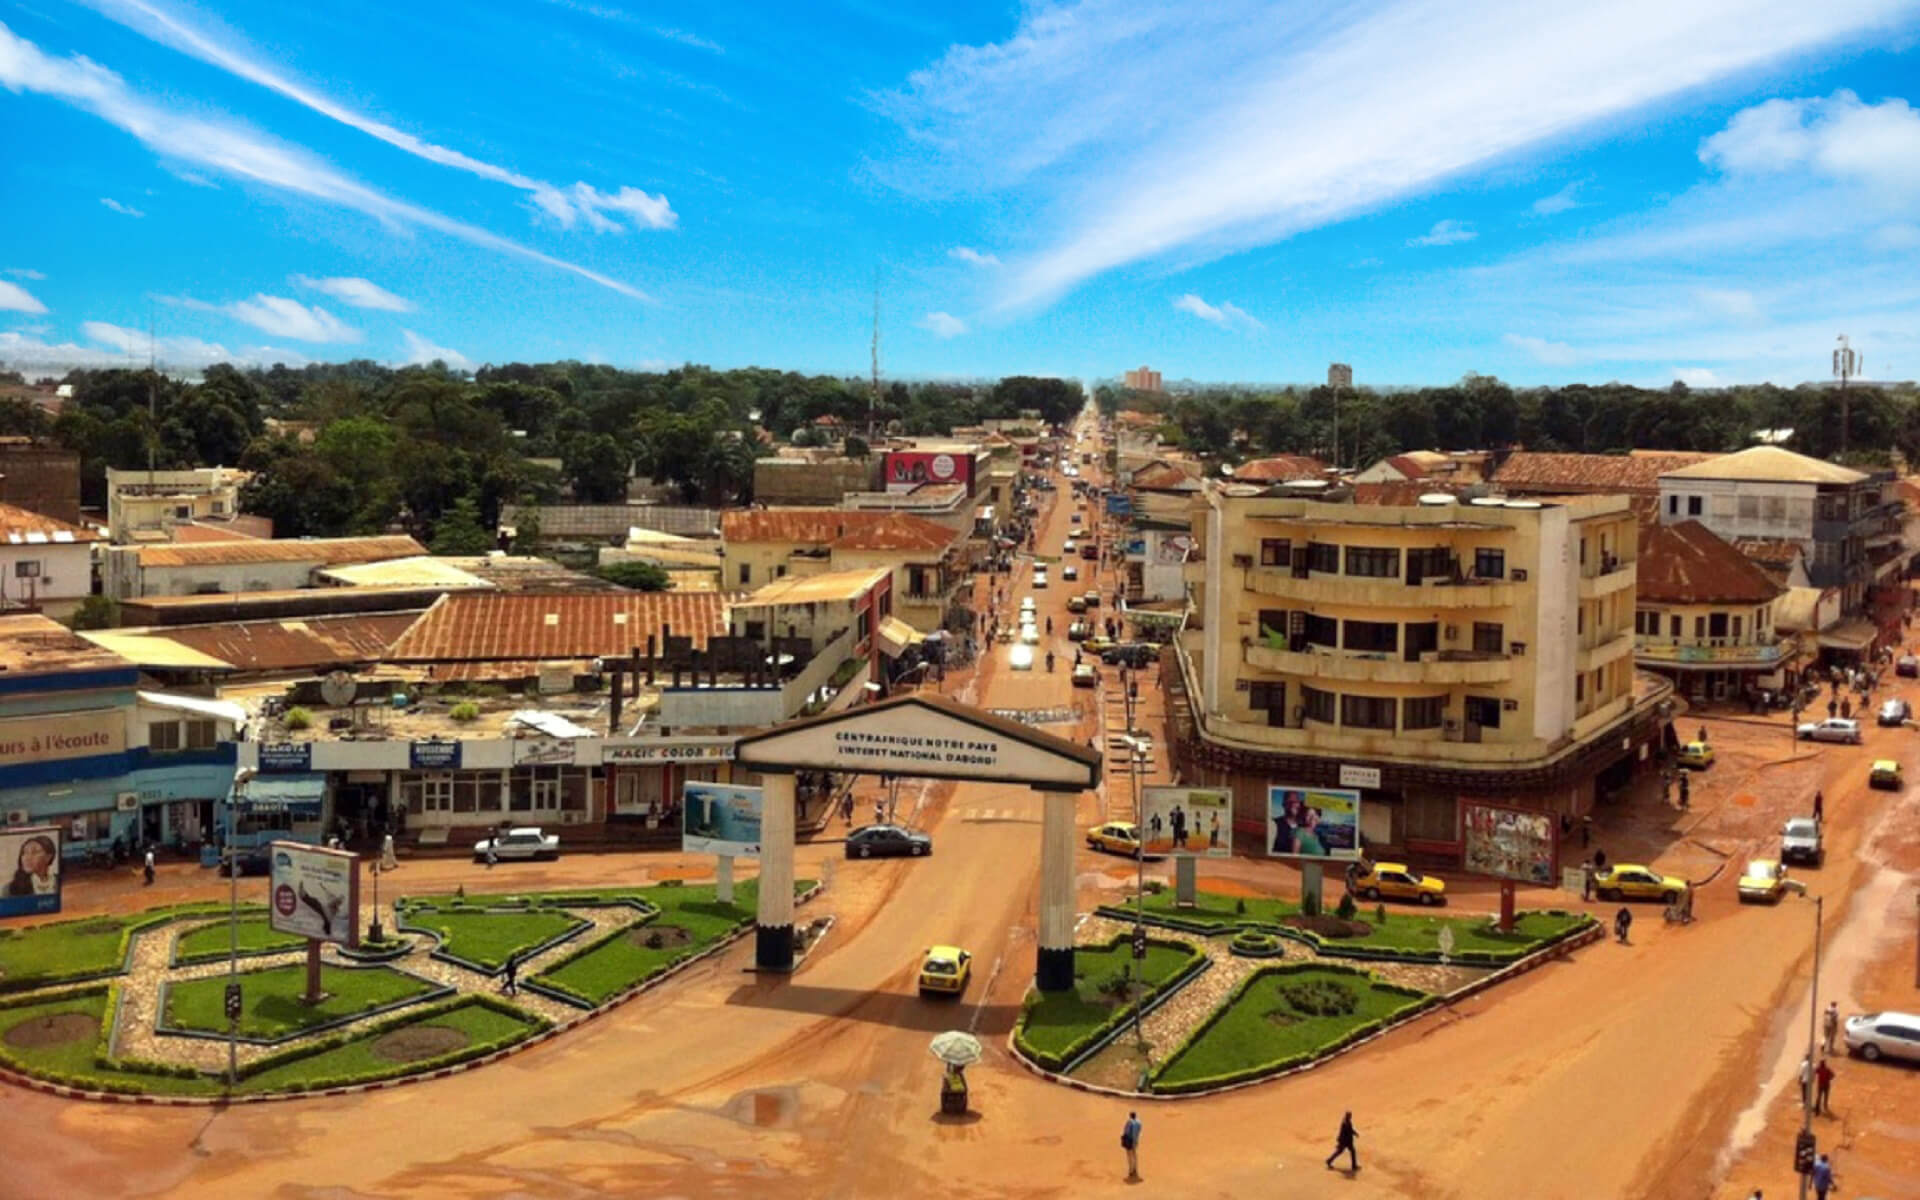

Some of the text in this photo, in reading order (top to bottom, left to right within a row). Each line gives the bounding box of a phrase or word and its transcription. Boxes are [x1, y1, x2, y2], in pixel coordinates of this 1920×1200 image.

[30, 736, 41, 752] à
[46, 731, 110, 750] l'écoute
[835, 731, 998, 752] CENTRAFRIQUE NOTRE PAYS
[612, 748, 656, 759] MAGIC
[662, 747, 704, 758] COLOR
[890, 750, 942, 761] NATIONAL
